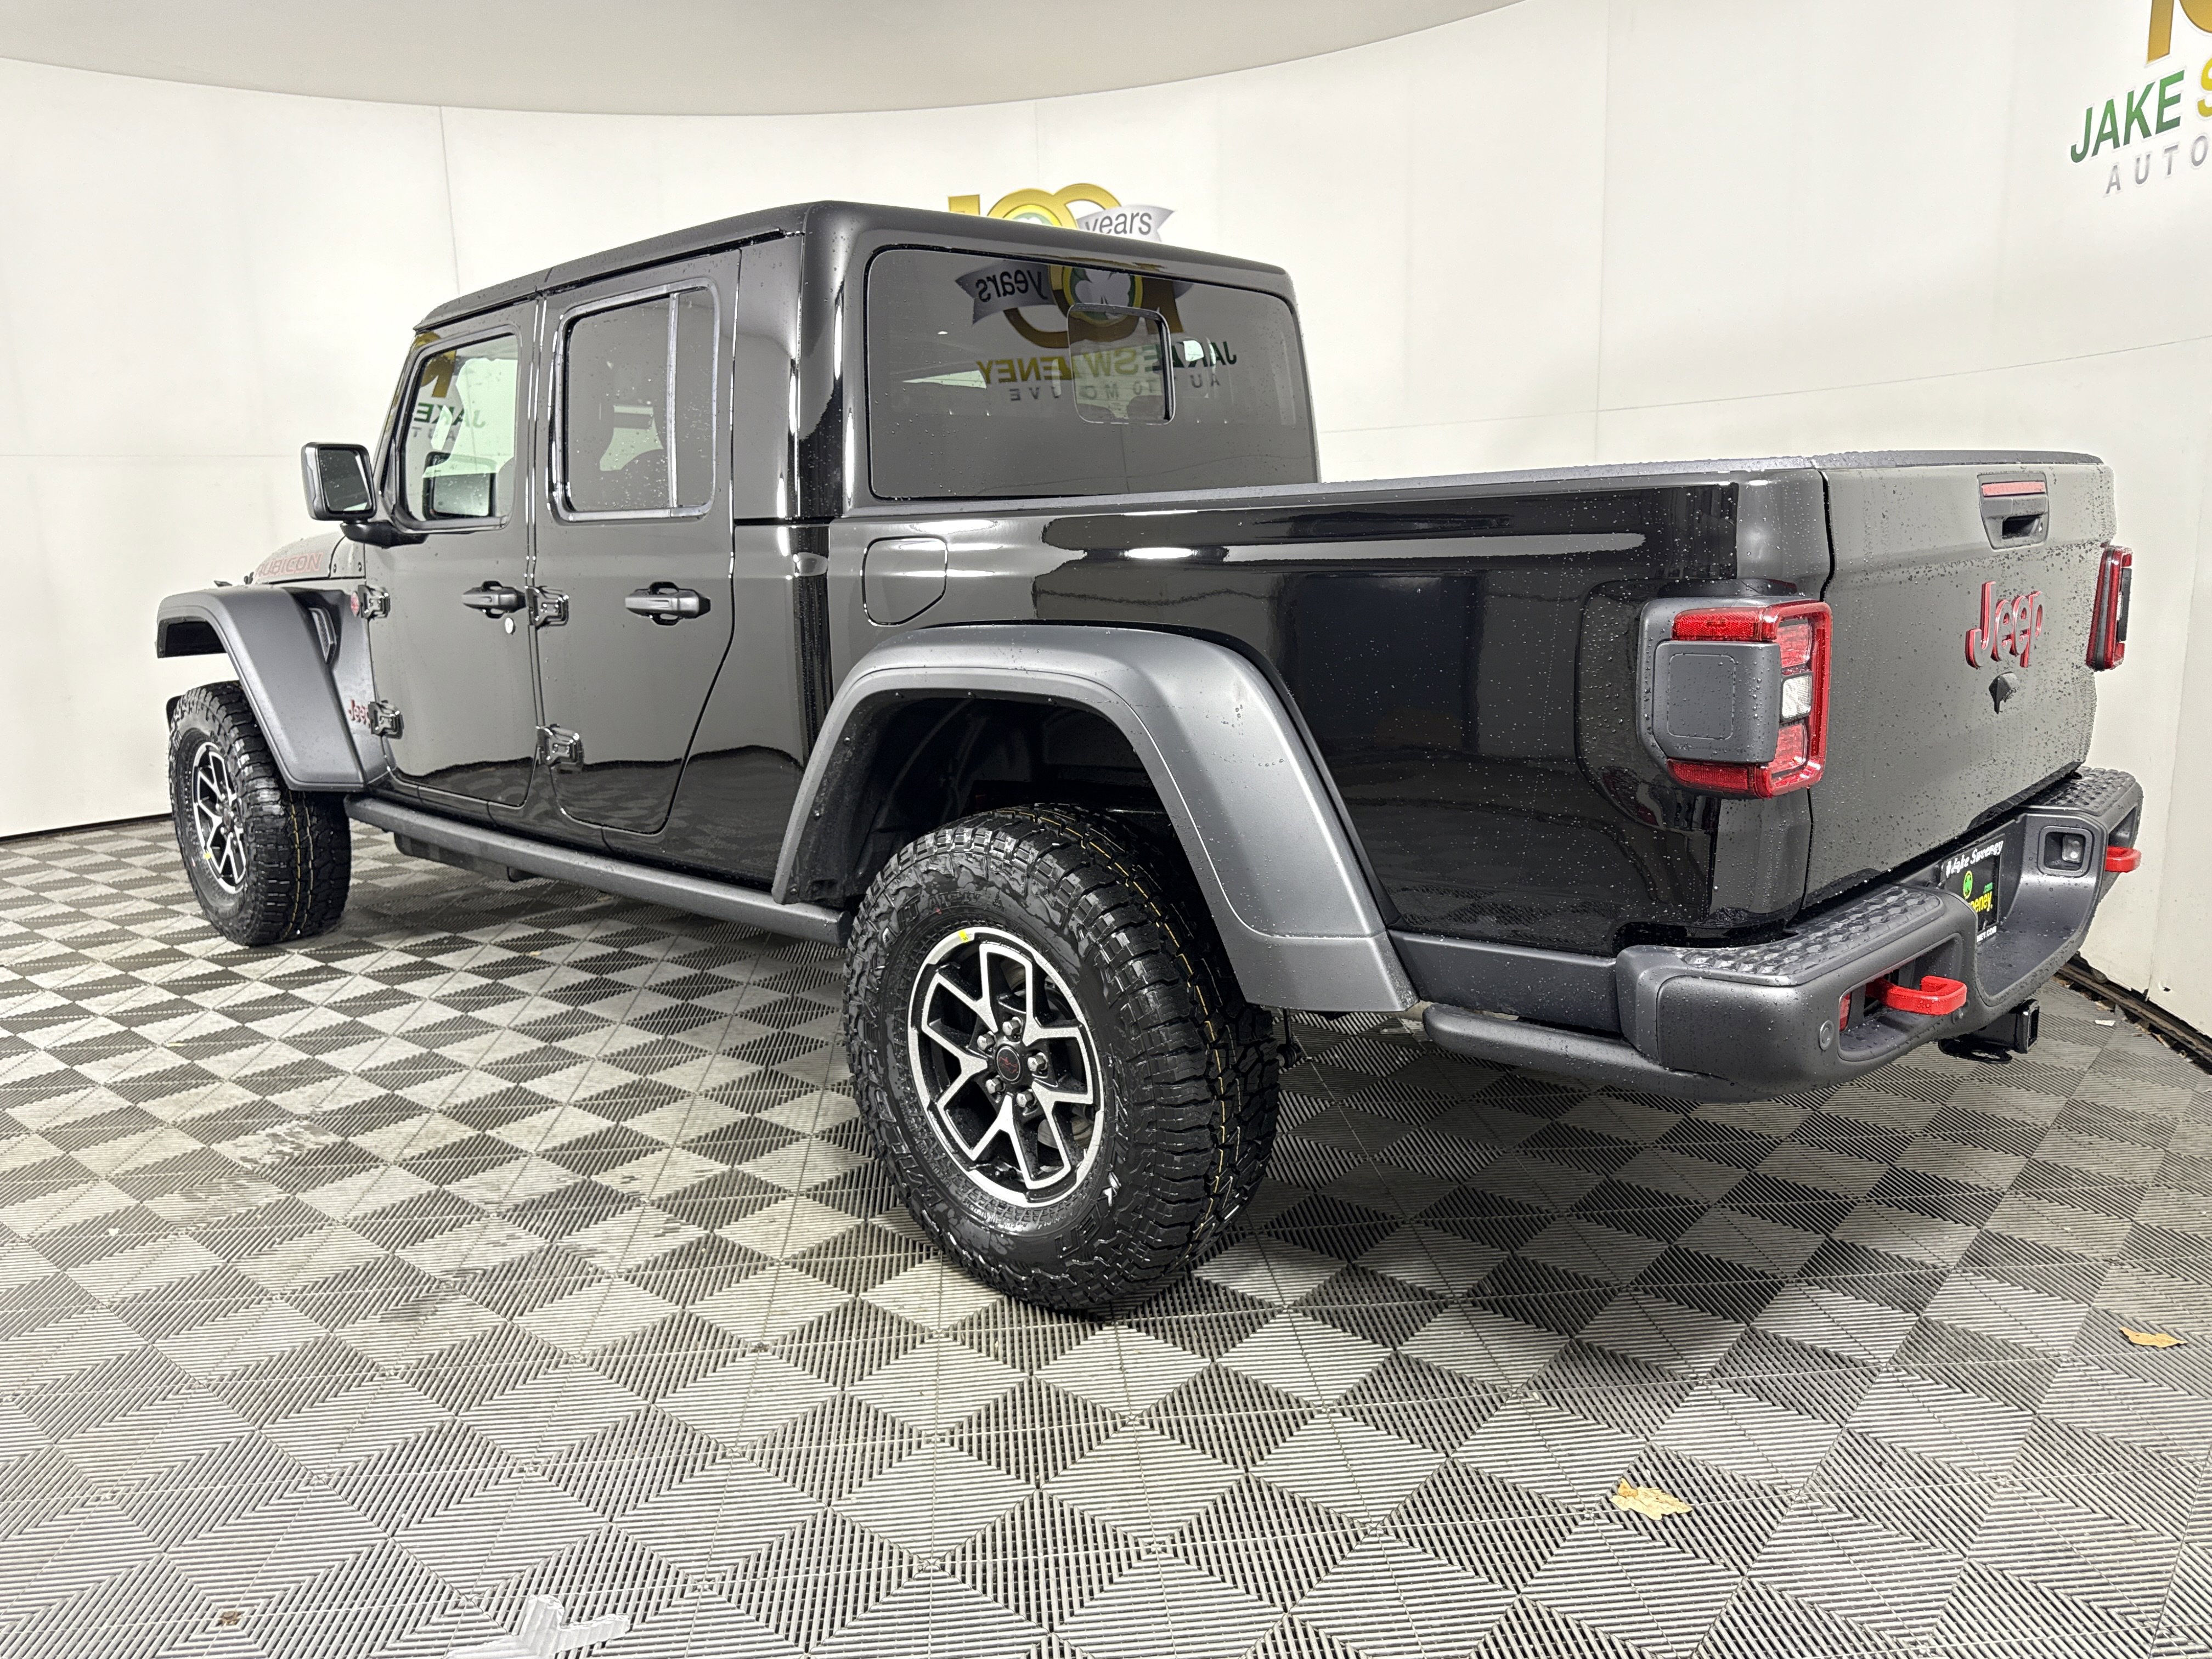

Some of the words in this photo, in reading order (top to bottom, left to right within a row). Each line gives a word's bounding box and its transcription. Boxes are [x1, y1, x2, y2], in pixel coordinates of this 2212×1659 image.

[2070, 69, 2185, 163] JAKE
[2105, 135, 2209, 195] AUTO
[254, 551, 324, 578] RUBICON
[1964, 580, 2044, 669] Jeep
